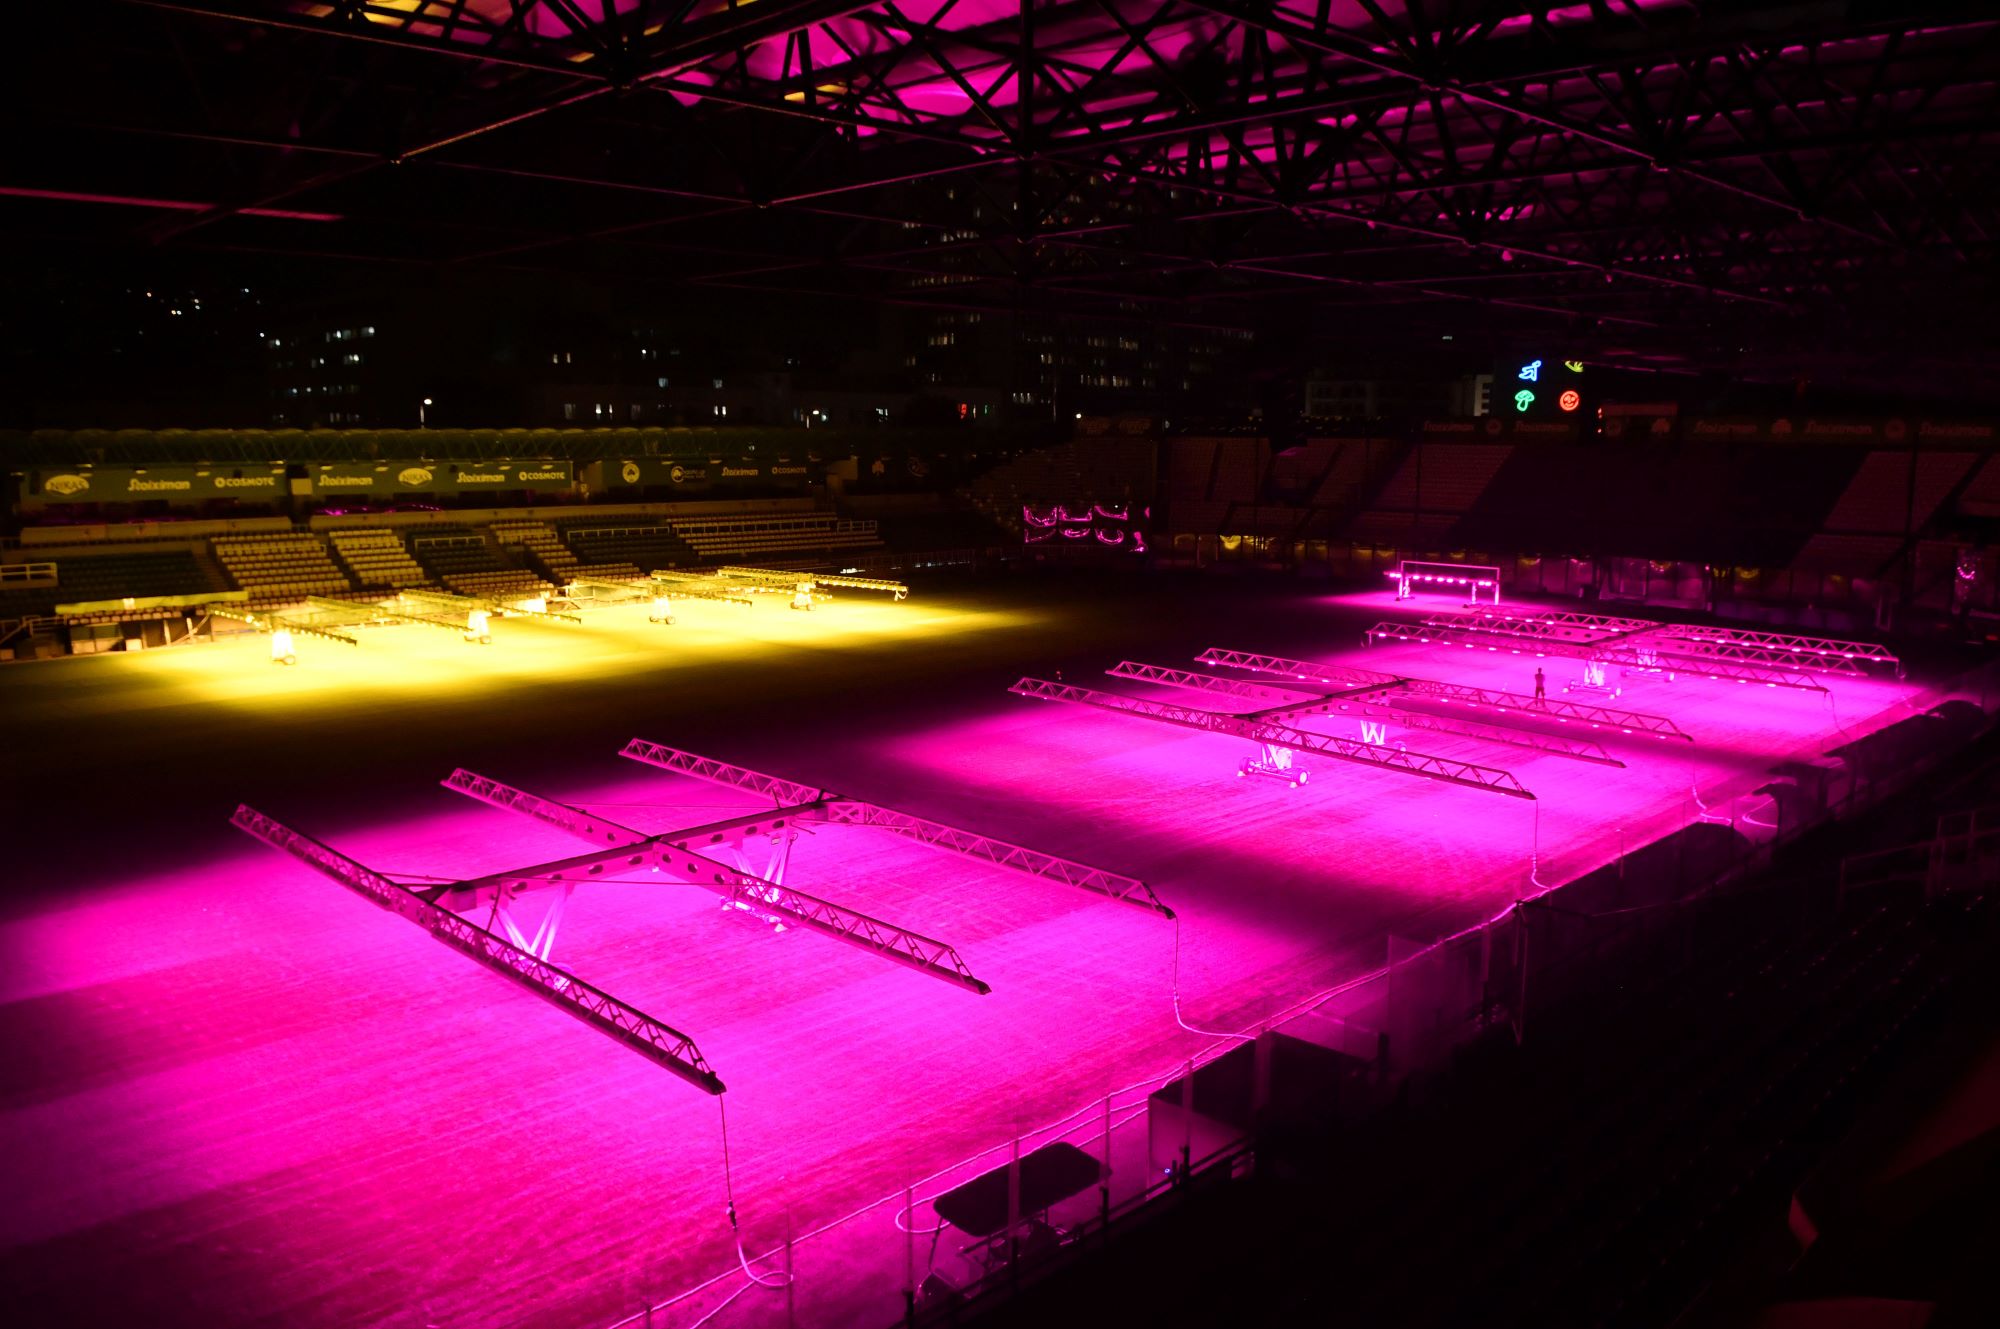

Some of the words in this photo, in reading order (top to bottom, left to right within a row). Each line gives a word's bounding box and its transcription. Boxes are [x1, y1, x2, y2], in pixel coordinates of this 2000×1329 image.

[318, 474, 373, 487] Stoiximan
[456, 471, 505, 483] Stoiximan
[527, 471, 565, 480] COSMOTE
[128, 478, 191, 491] Stoiximan
[226, 477, 275, 487] COSMOTE
